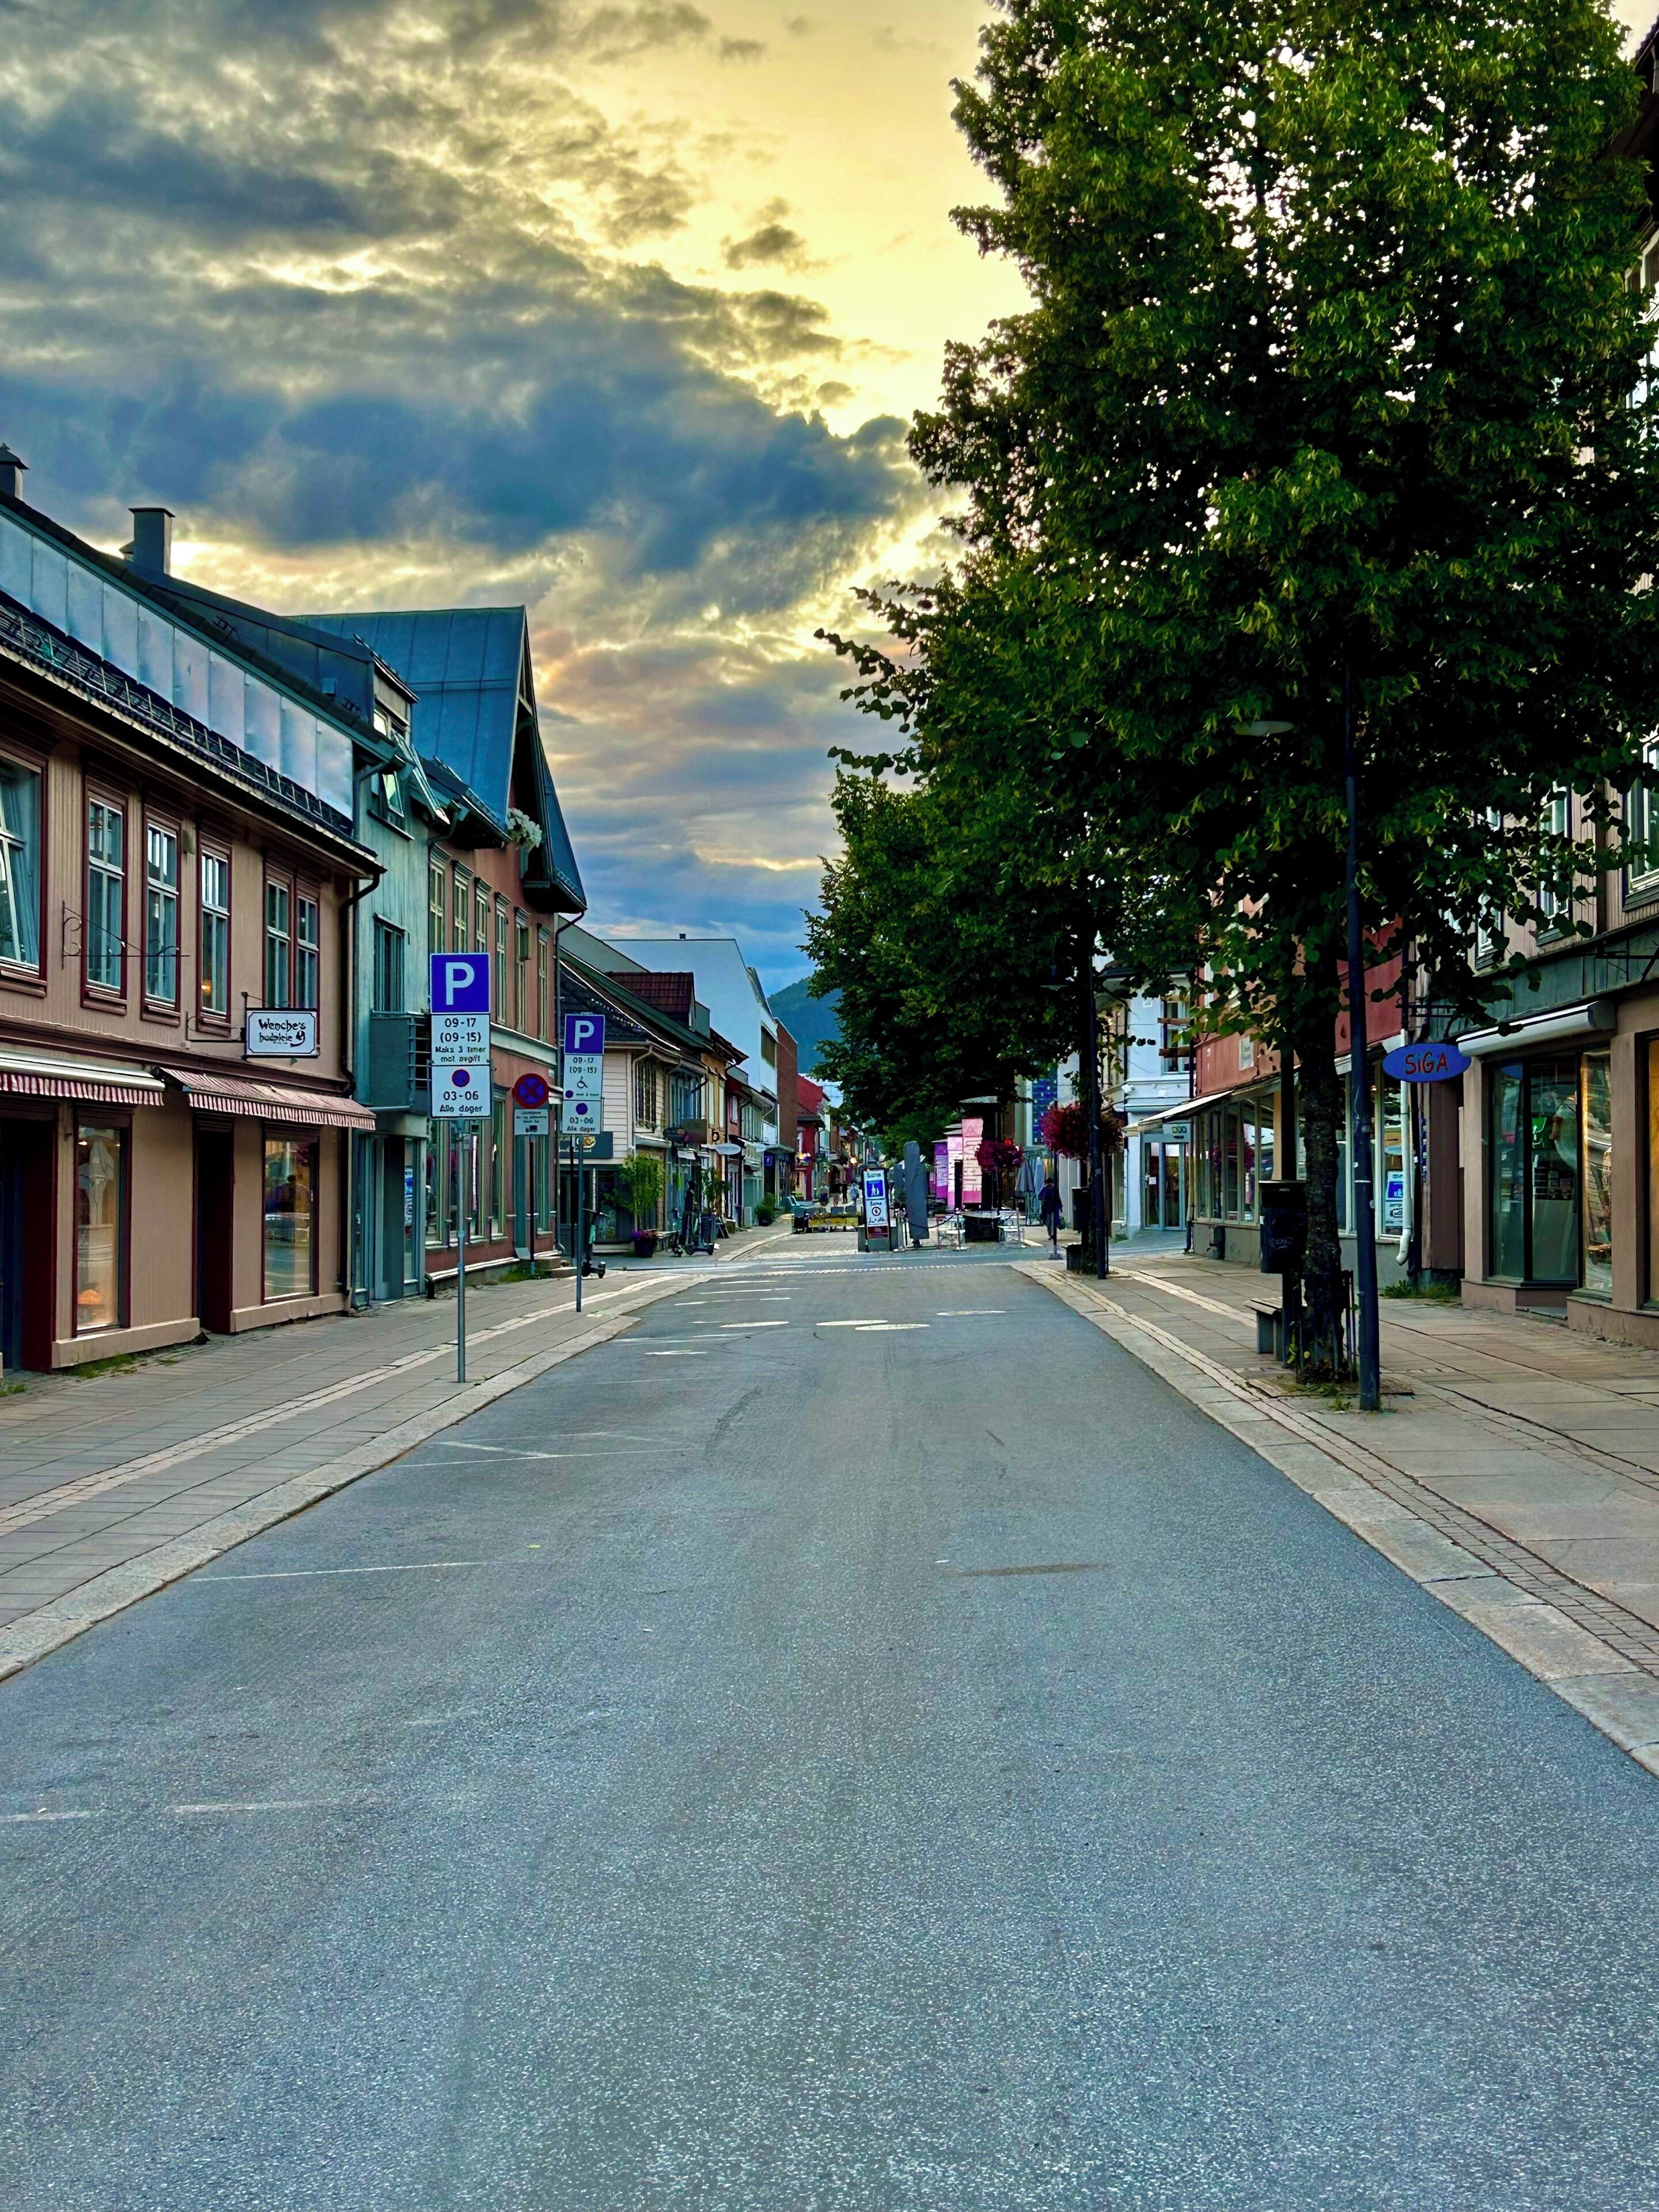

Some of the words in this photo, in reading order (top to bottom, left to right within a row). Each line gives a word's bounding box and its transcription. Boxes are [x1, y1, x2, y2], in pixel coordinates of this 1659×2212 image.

[445, 961, 475, 1005] P
[258, 1018, 306, 1032] Wenche's
[445, 1017, 476, 1028] 09-17
[440, 1031, 482, 1043] (09-15)
[574, 1020, 594, 1049] P
[443, 1090, 479, 1101] 03-06
[440, 1104, 454, 1112] Alle
[459, 1104, 483, 1114] dager
